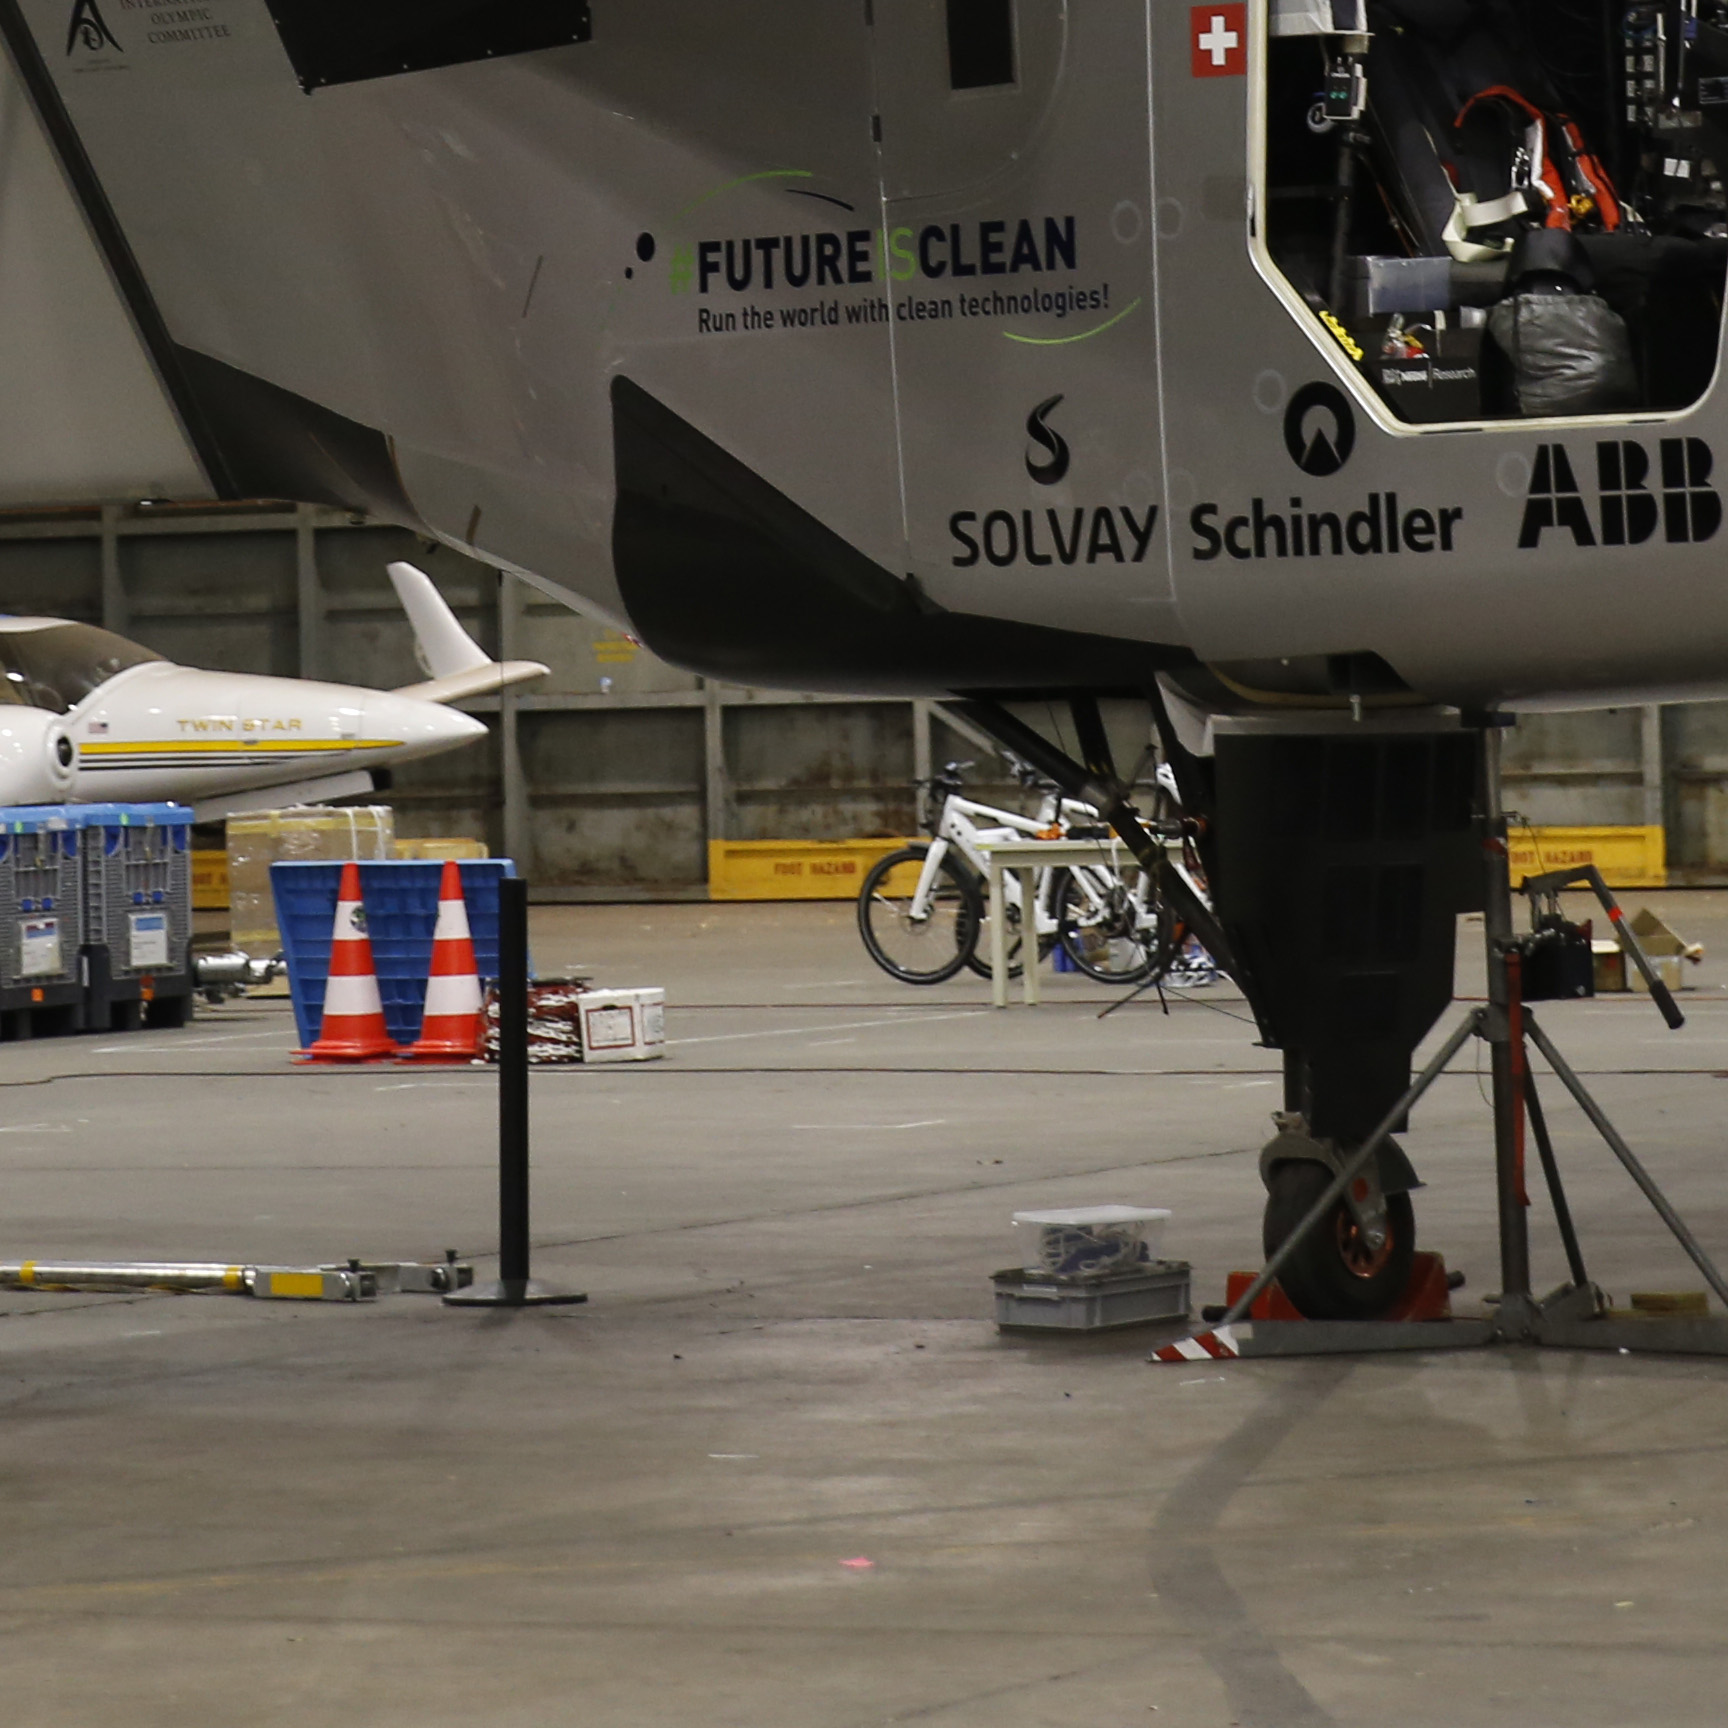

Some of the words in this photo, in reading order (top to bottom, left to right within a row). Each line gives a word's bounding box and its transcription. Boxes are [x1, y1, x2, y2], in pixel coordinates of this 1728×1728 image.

[147, 24, 231, 45] COMMITTEE
[150, 7, 212, 25] OLYMPIC
[698, 308, 736, 333] Run
[742, 303, 774, 328] the
[780, 300, 839, 326] world
[845, 296, 890, 324] with
[896, 294, 953, 321] clean
[959, 283, 1109, 320] technologies!
[1517, 437, 1722, 549] ABB
[948, 505, 1159, 567] SOLVAY
[1190, 492, 1463, 560] Schindler
[176, 719, 235, 733] TWIN
[242, 718, 303, 732] STAR
